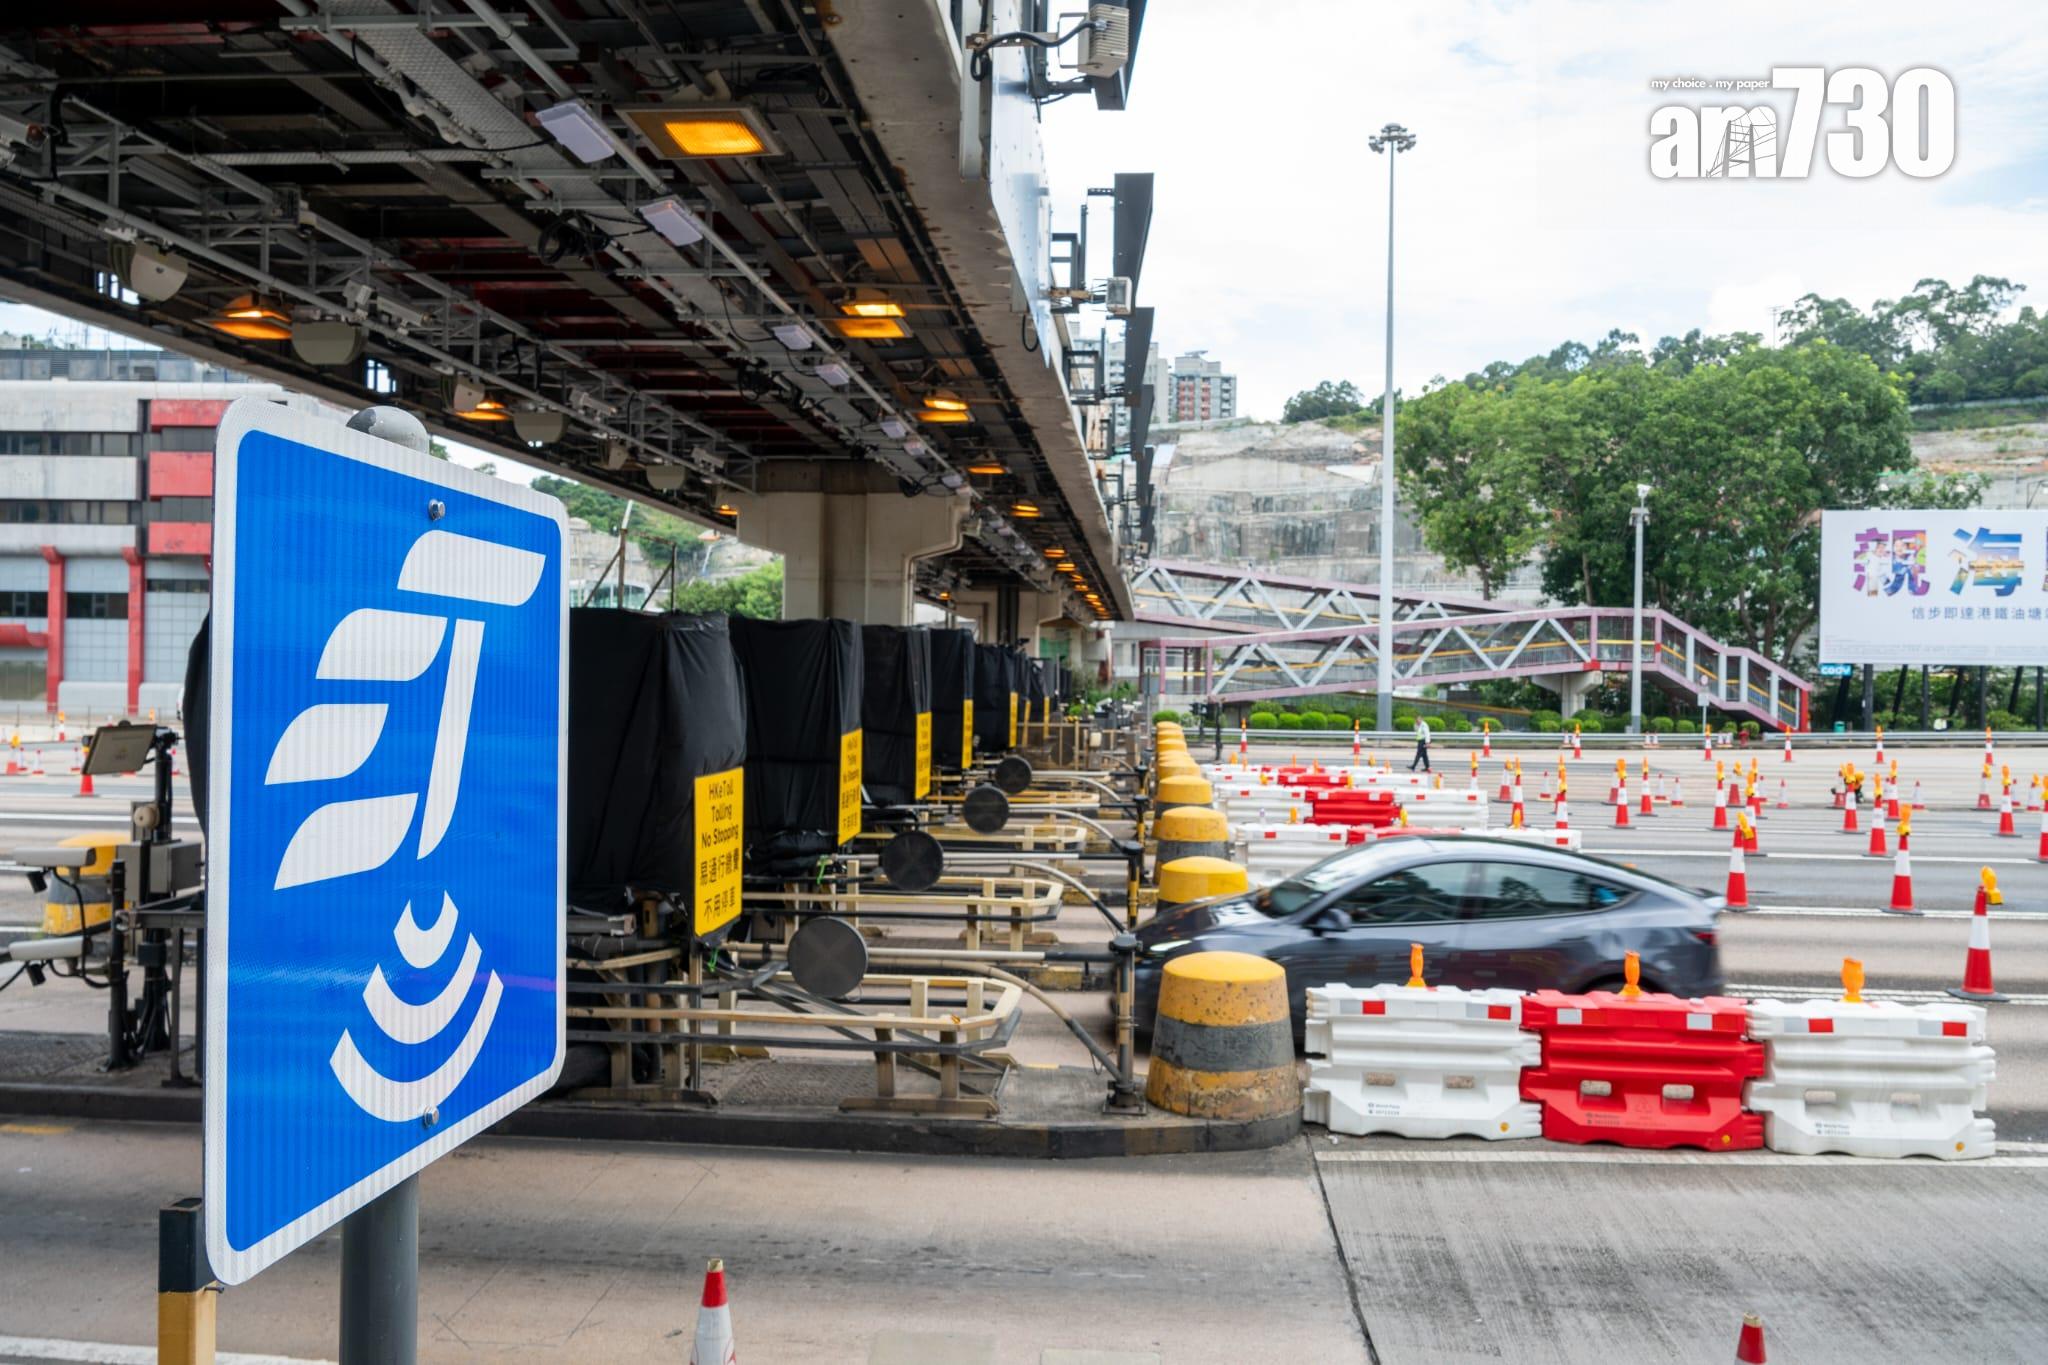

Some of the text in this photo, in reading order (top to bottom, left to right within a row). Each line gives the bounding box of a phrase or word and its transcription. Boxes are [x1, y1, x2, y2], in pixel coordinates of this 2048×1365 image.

[1853, 527, 2048, 597] 親海
[1912, 606, 2048, 620] 信步即達港鐵油塘
[709, 779, 734, 800] HKeToll
[711, 804, 732, 822] Tolling
[701, 825, 739, 849] No Stopping
